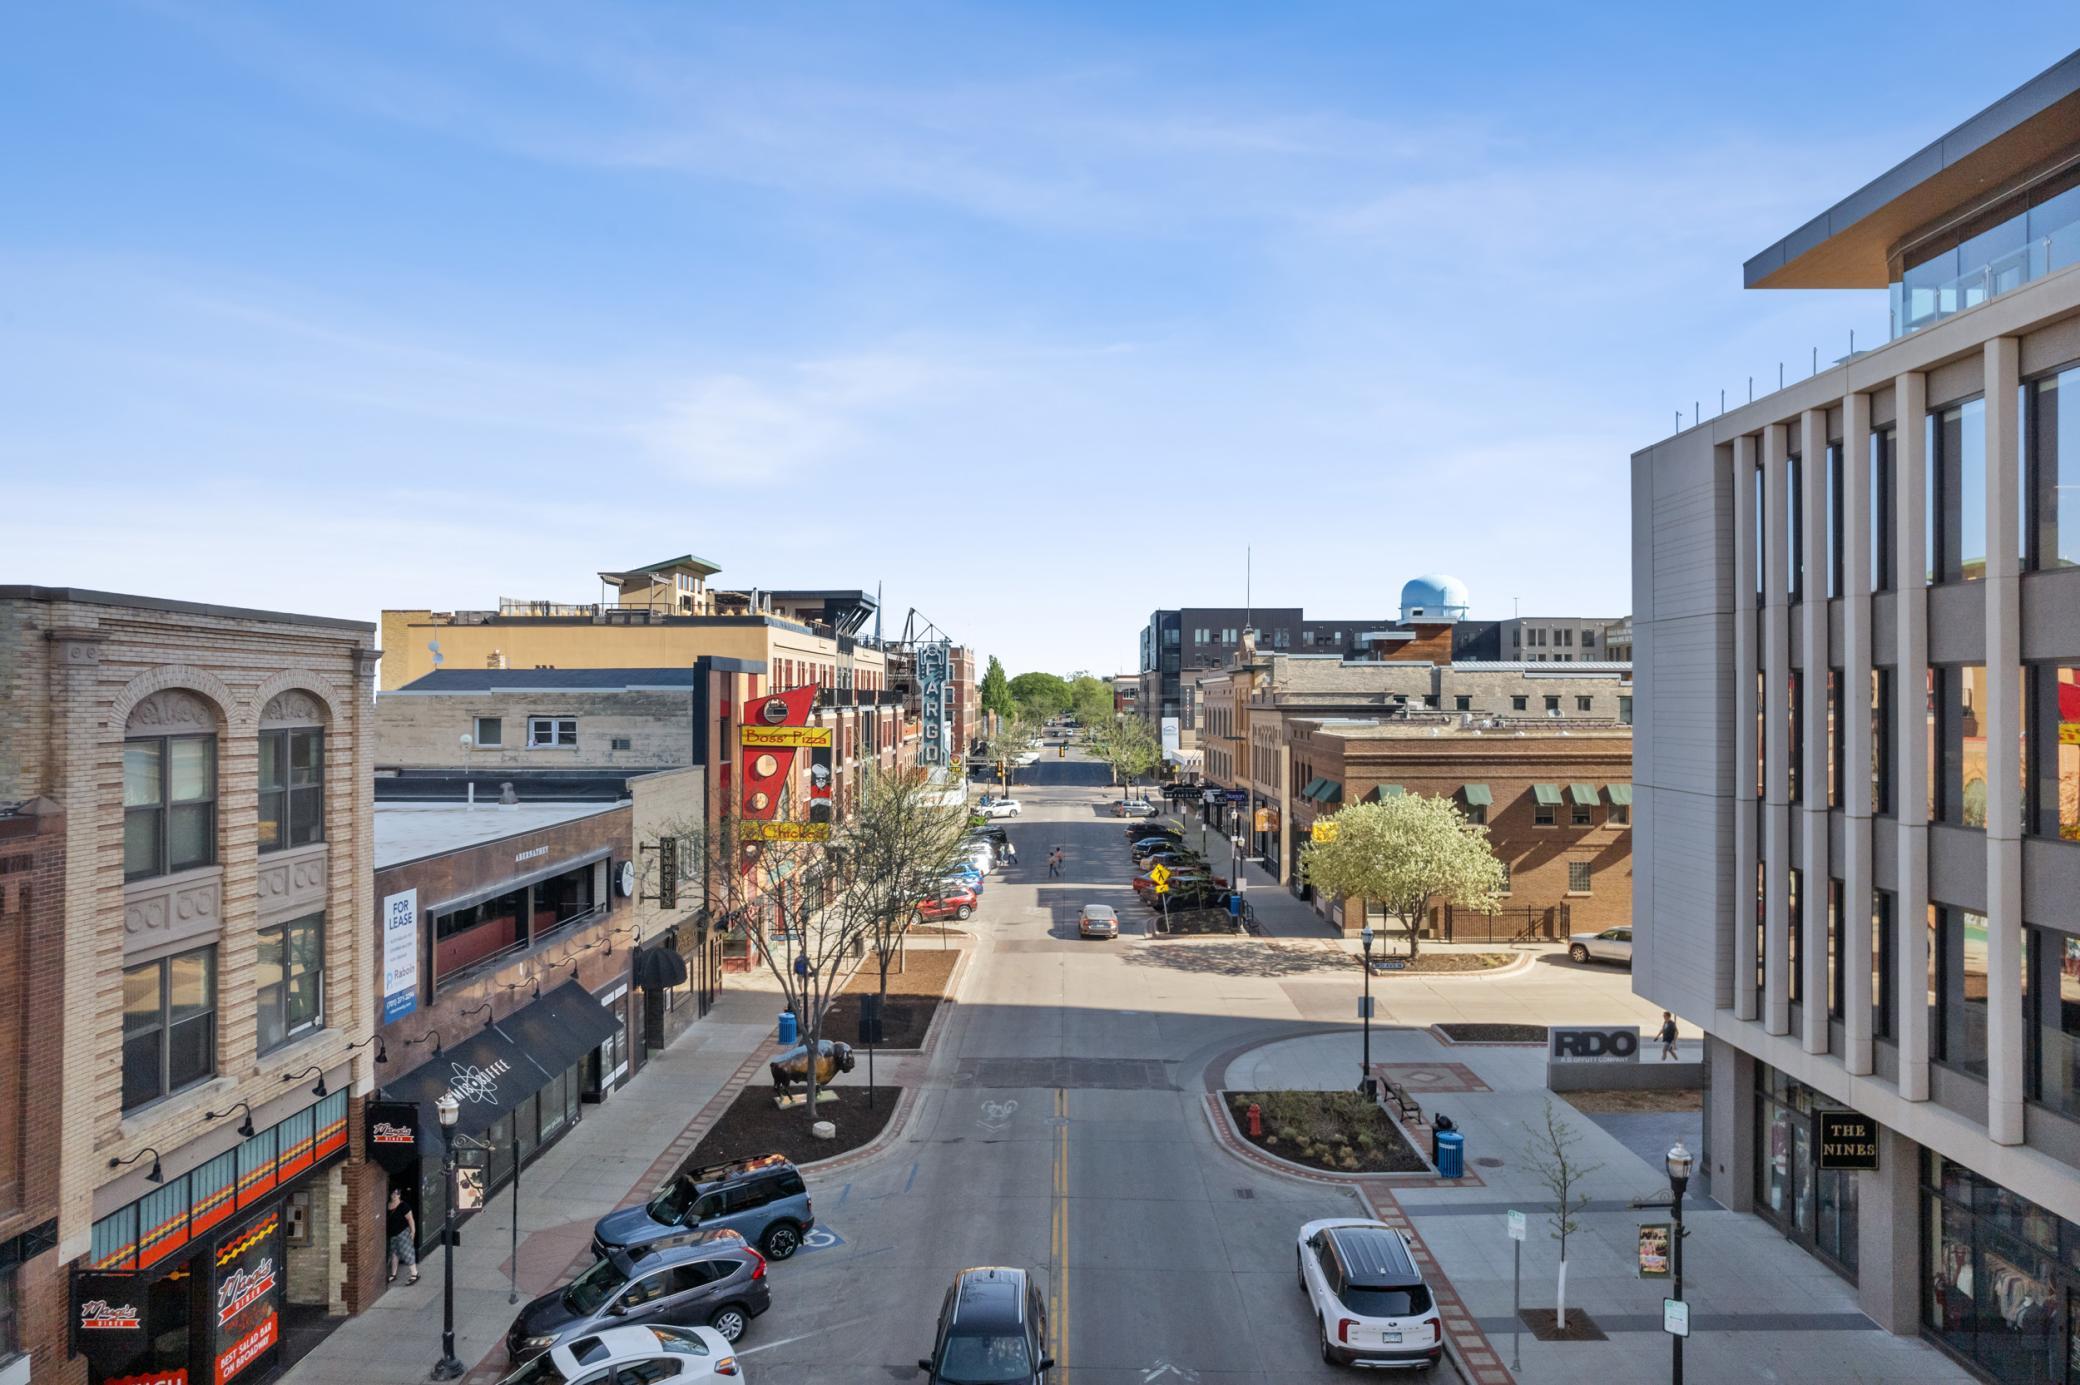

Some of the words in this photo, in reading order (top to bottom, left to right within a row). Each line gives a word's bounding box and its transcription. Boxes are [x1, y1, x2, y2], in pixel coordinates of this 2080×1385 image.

[926, 662, 939, 761] FARGO
[793, 731, 827, 744] Pizza
[393, 900, 409, 915] FOR
[389, 911, 413, 930] LEASE
[1555, 1031, 1638, 1057] RDO
[1831, 1124, 1866, 1137] THE
[1823, 1143, 1876, 1156] NINES
[220, 1349, 238, 1369] BEST
[239, 1332, 259, 1355] SALAD
[260, 1321, 272, 1338] BAR
[223, 1363, 235, 1378] ON
[236, 1335, 270, 1369] BROADWAY
